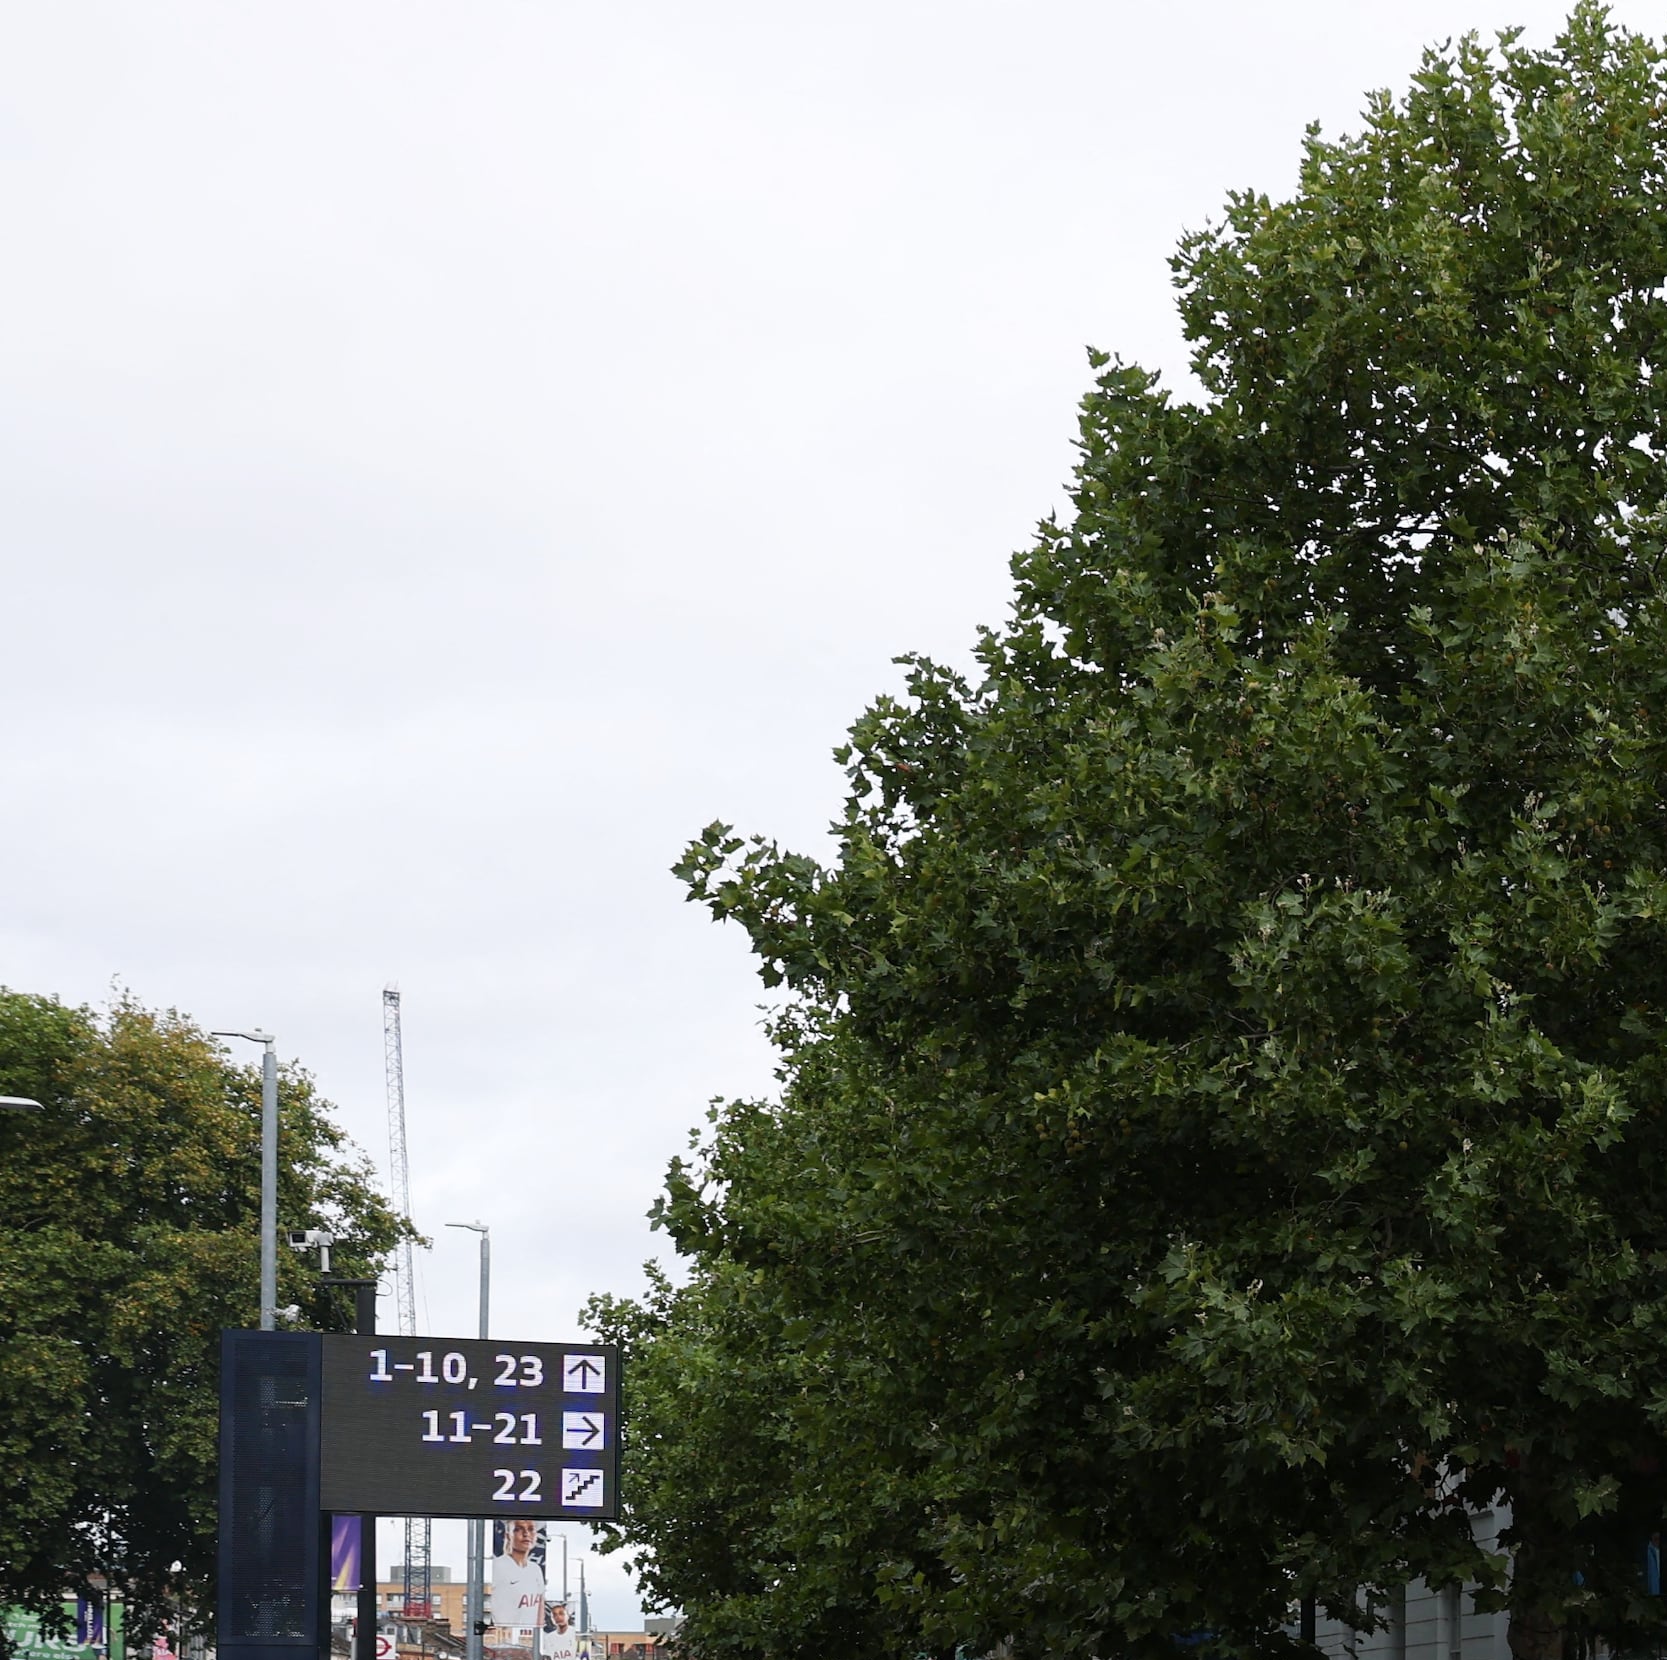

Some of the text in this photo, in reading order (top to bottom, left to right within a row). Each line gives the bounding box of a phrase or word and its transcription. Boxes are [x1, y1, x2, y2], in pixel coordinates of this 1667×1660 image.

[370, 1350, 543, 1390] 1-10, 23
[422, 1410, 542, 1445] 11-21
[492, 1469, 541, 1501] 22
